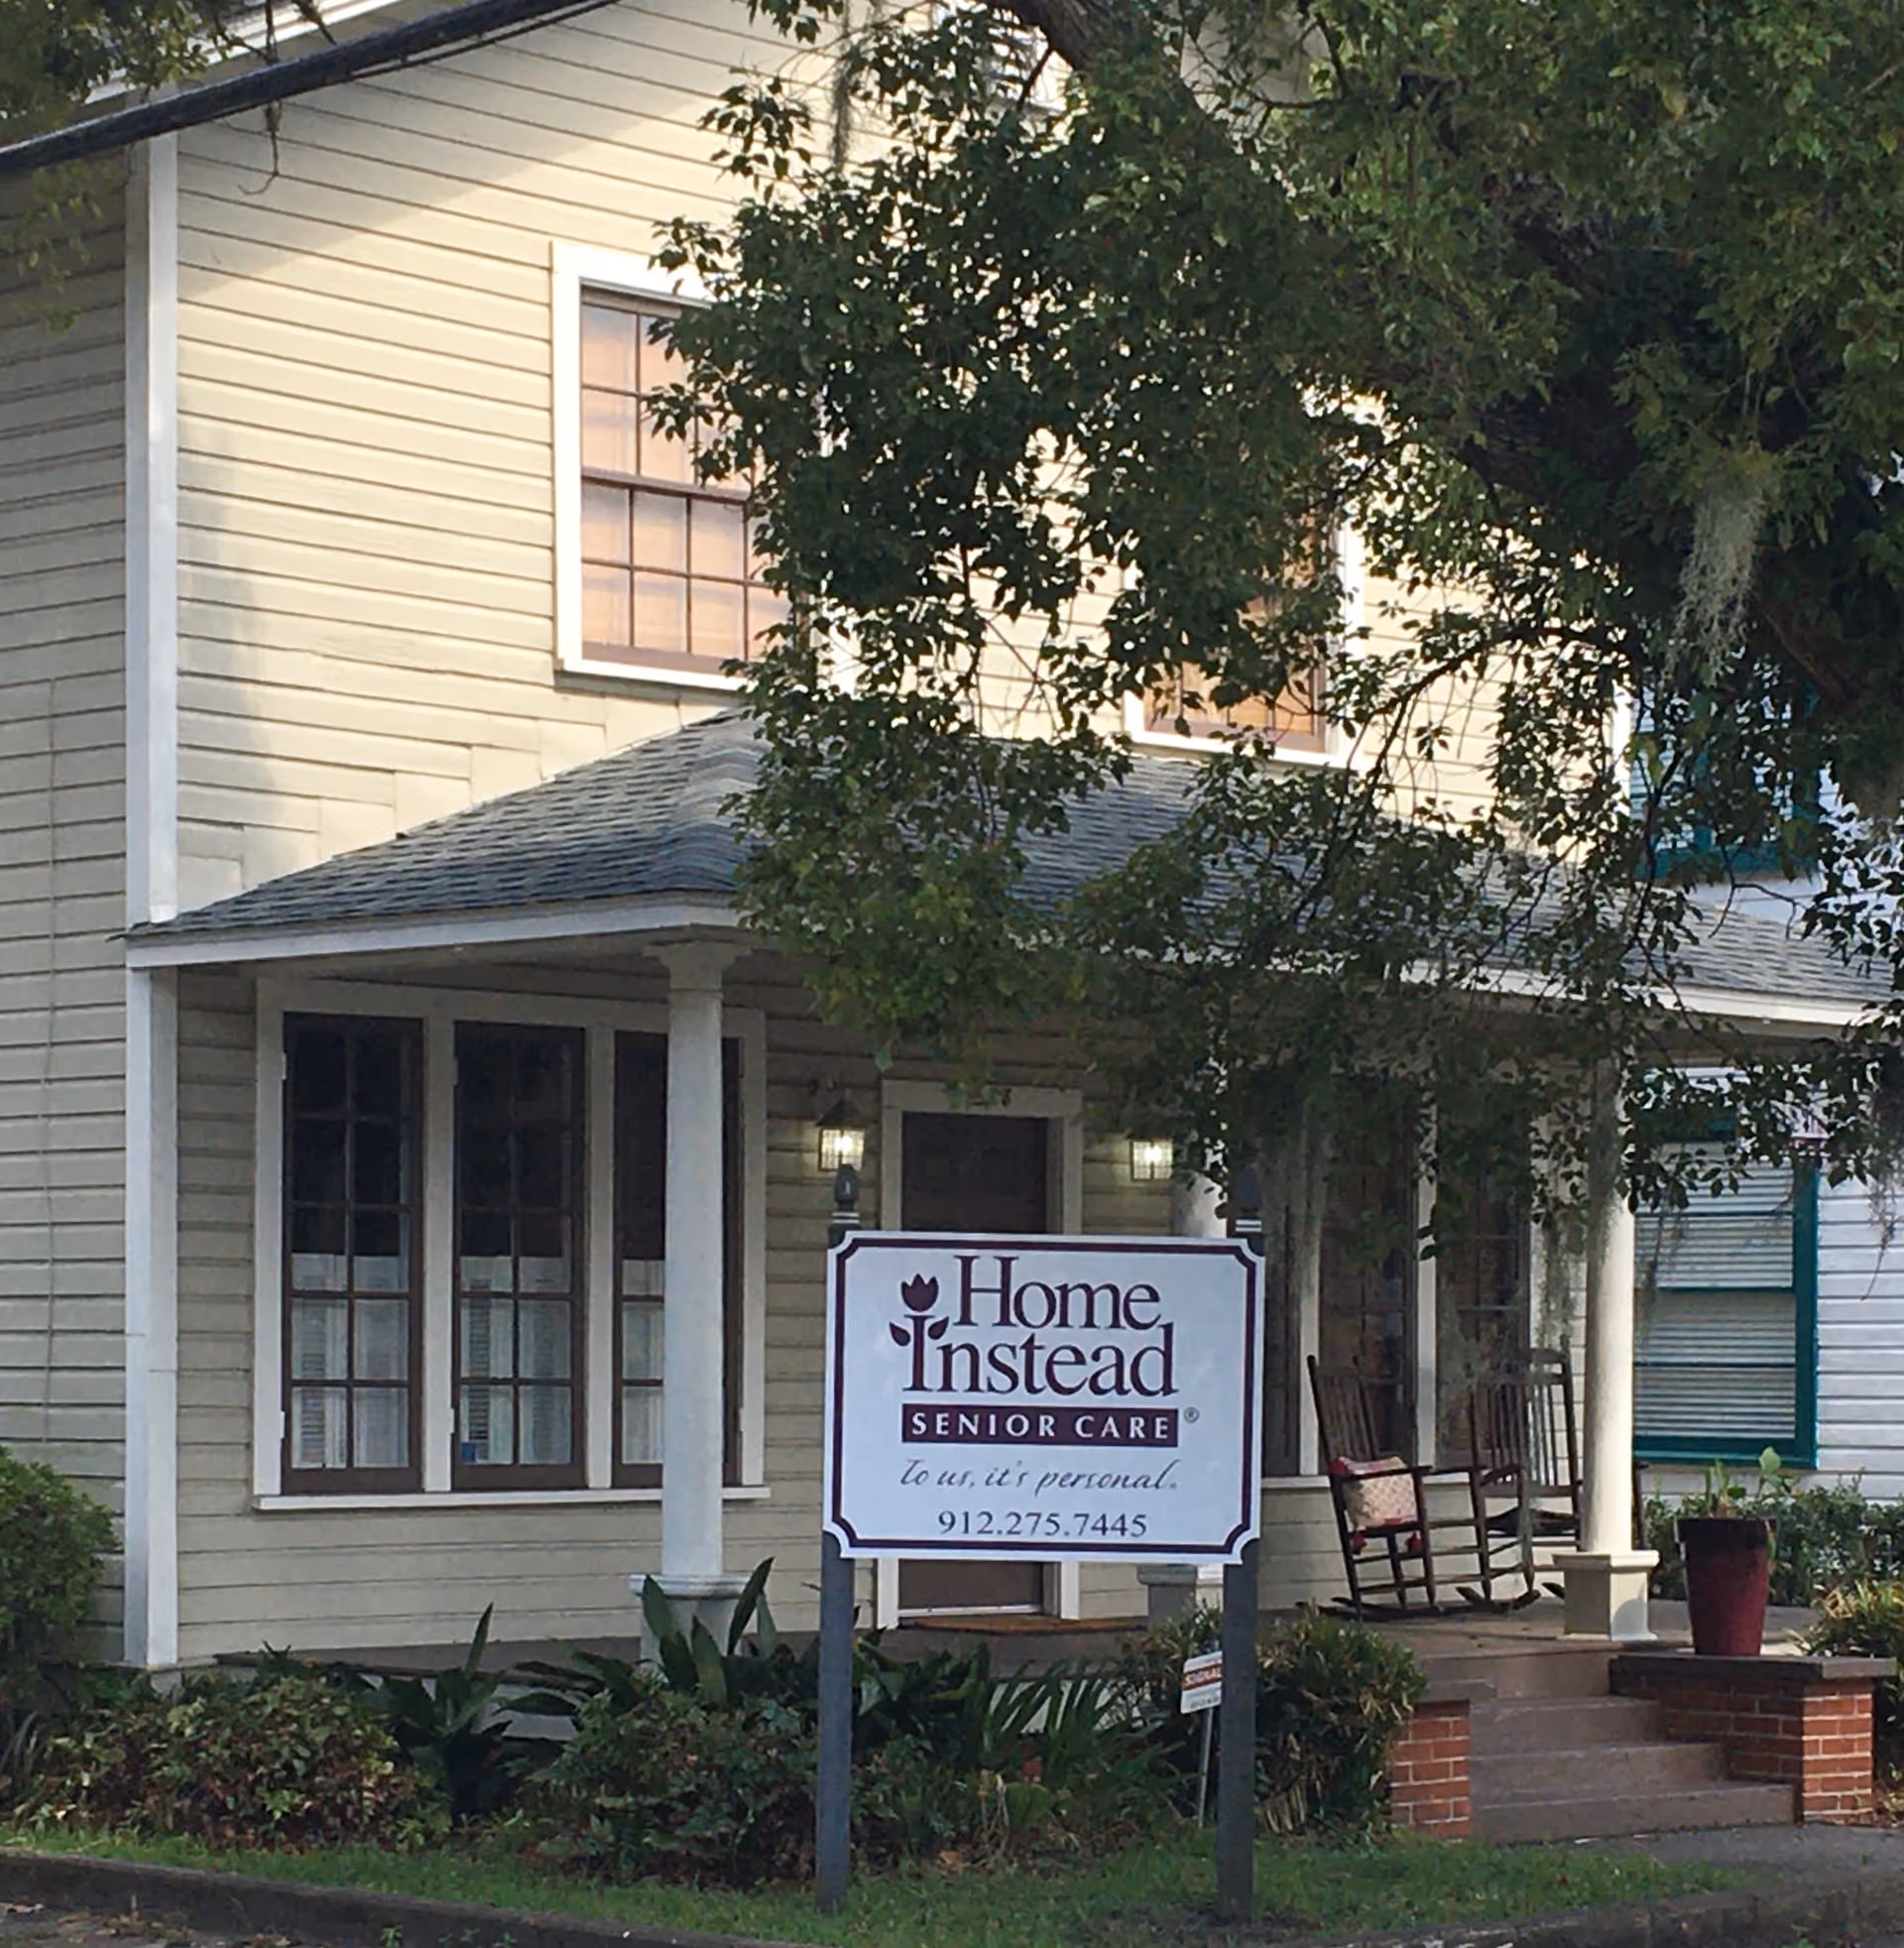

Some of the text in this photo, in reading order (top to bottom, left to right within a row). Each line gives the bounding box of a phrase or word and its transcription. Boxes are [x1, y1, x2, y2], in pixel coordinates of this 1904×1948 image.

[953, 1255, 1161, 1330] Home
[902, 1314, 1178, 1397] Instead
[911, 1412, 1169, 1440] SENIOR CARE
[899, 1459, 930, 1486] To
[937, 1470, 976, 1489] us,
[985, 1460, 1029, 1489] it's
[938, 1511, 1147, 1538] 912.275.7445
